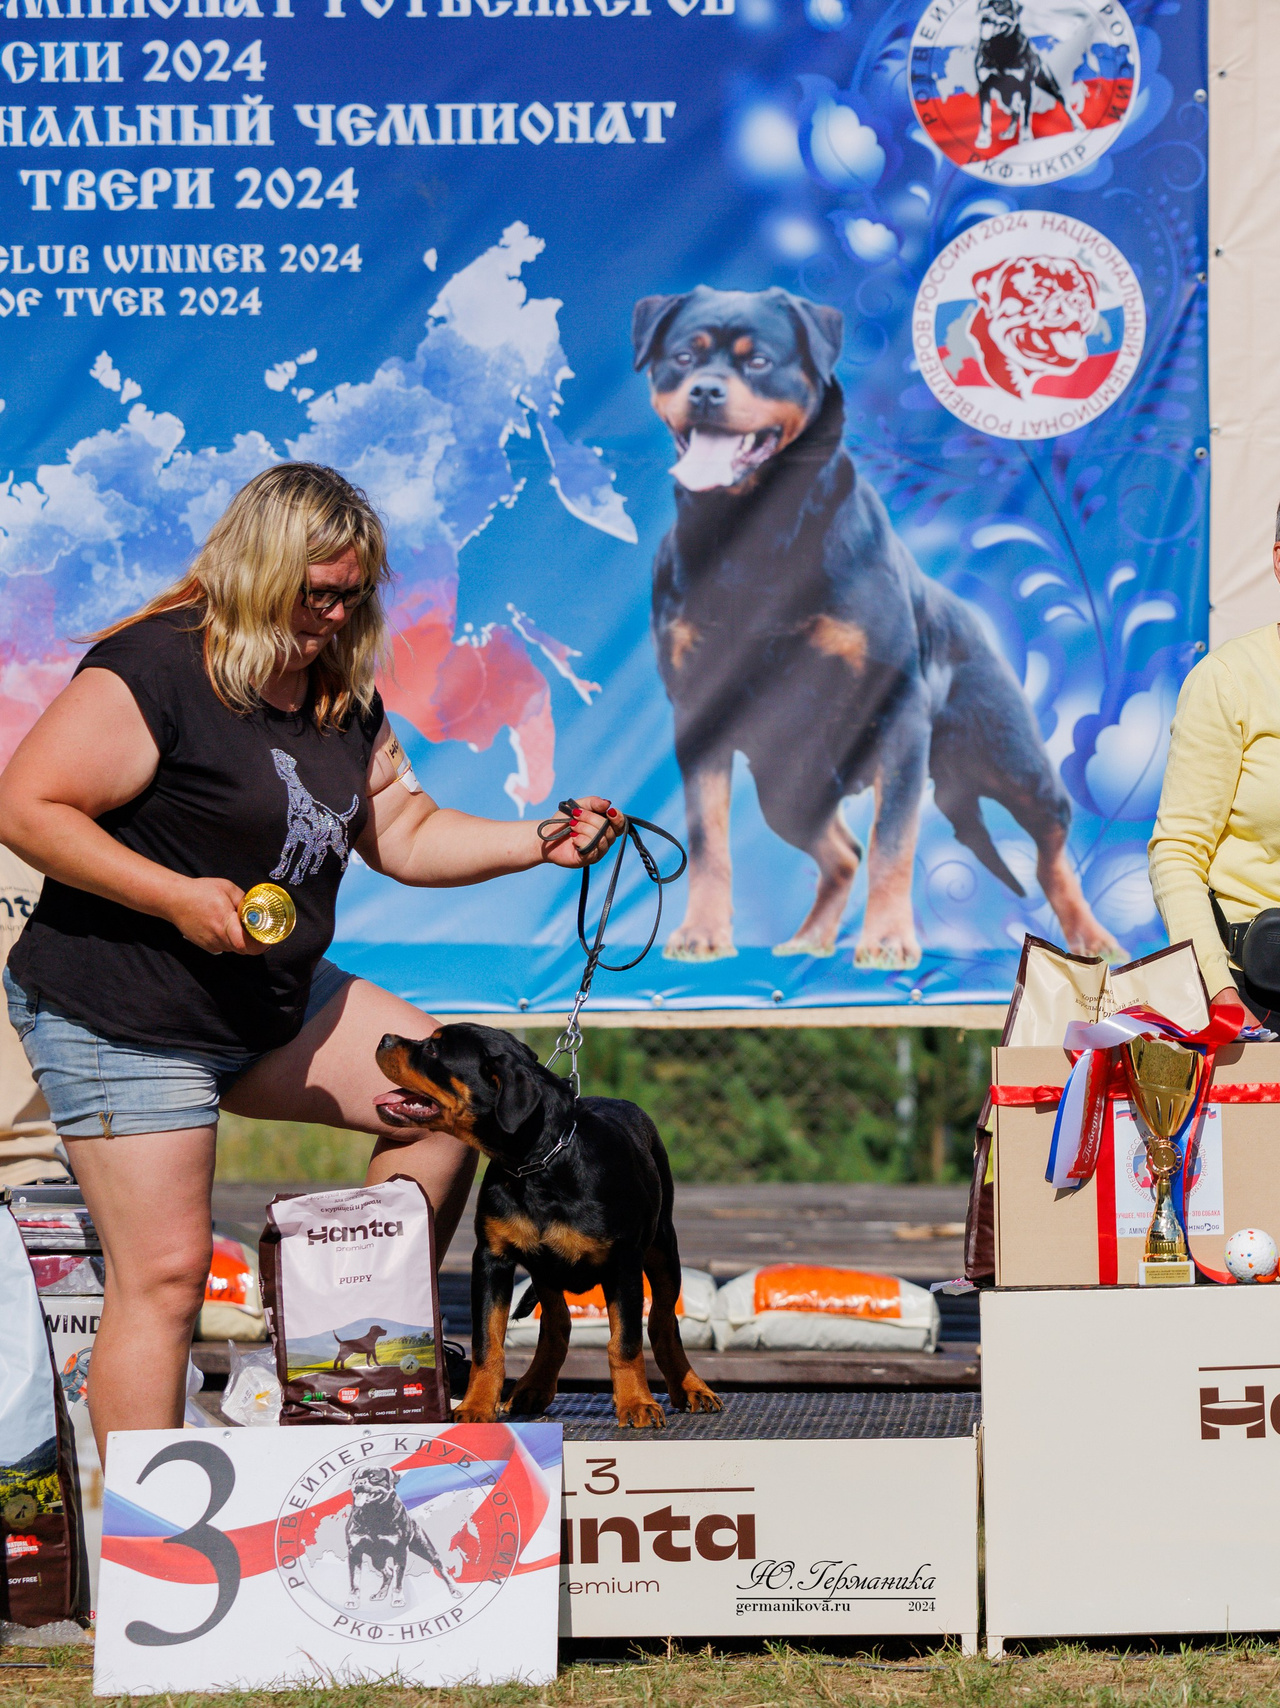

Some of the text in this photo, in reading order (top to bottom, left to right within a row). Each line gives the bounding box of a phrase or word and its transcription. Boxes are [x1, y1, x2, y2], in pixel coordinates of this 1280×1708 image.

[143, 39, 267, 82] 2024
[294, 102, 677, 146] ЧЕМПИОНАТ
[966, 144, 1087, 179] РКФ-НКПР
[20, 167, 358, 211] ТВЕРИ 2024
[104, 244, 266, 274] WINNER
[280, 244, 362, 272] 2024
[916, 233, 979, 313] РОССИИ
[980, 215, 1028, 240] 2024
[56, 287, 166, 316] TVER
[179, 287, 262, 316] 2024
[1018, 215, 1139, 437] НАЦИОНАЛЬНЫЙ ЧЕМПИОНАТ
[307, 1219, 404, 1246] Hanta
[336, 1242, 375, 1253] premium
[339, 1274, 372, 1285] PUPPY
[584, 1458, 620, 1495] 3
[279, 1437, 519, 1590] РОТВЕЙЛЕР КЛУБ РОССИИ
[125, 1440, 242, 1646] 3
[561, 1505, 756, 1564] nta
[332, 1606, 465, 1642] РКФ-НКПР
